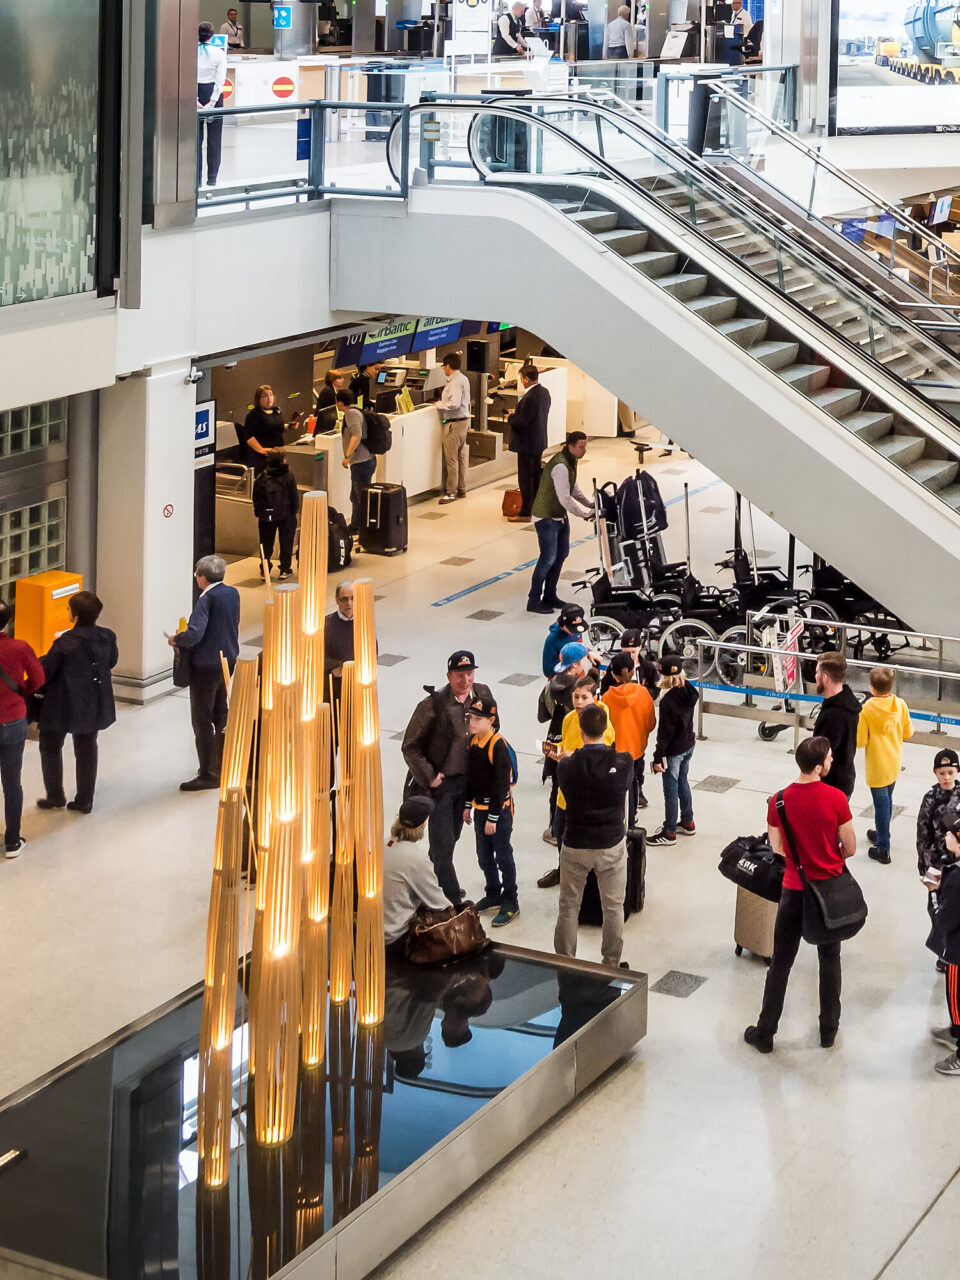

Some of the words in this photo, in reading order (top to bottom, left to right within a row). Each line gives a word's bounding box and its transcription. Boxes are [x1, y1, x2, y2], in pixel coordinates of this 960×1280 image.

[375, 321, 411, 340] irBaltic
[195, 422, 207, 433] AS
[696, 681, 719, 690] FINAVIA
[765, 691, 790, 699] FINAVIA
[930, 715, 956, 725] FINAVIA
